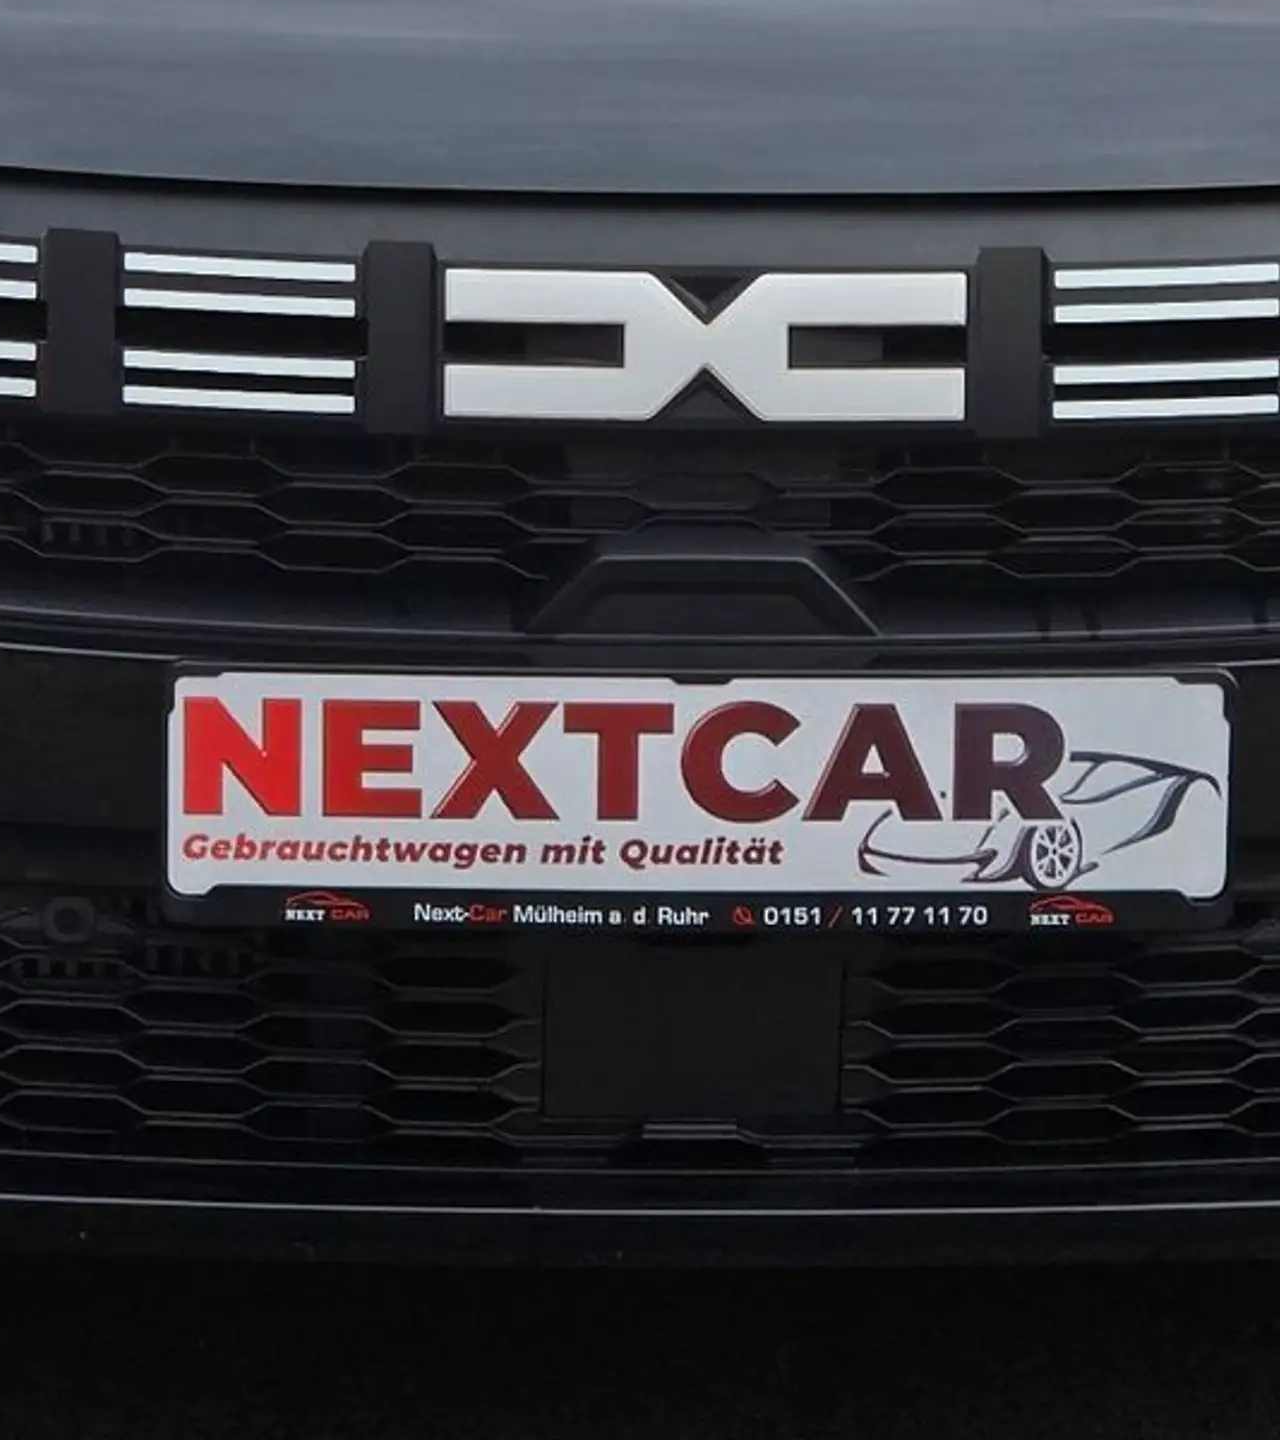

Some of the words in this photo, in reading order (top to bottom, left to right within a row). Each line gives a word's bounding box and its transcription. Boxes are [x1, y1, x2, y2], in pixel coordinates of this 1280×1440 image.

[182, 696, 1066, 823] NEXTCAR
[182, 833, 533, 869] Gebrauchtwagen
[540, 835, 606, 866] mit
[619, 837, 785, 868] Qualität
[284, 908, 326, 921] NEXT
[512, 903, 603, 925] Mülheim
[656, 906, 710, 926] Ruhr
[763, 905, 821, 926] 0151
[851, 906, 878, 926] 11
[887, 906, 916, 926] 77
[924, 906, 950, 926] 11
[958, 906, 989, 926] 70
